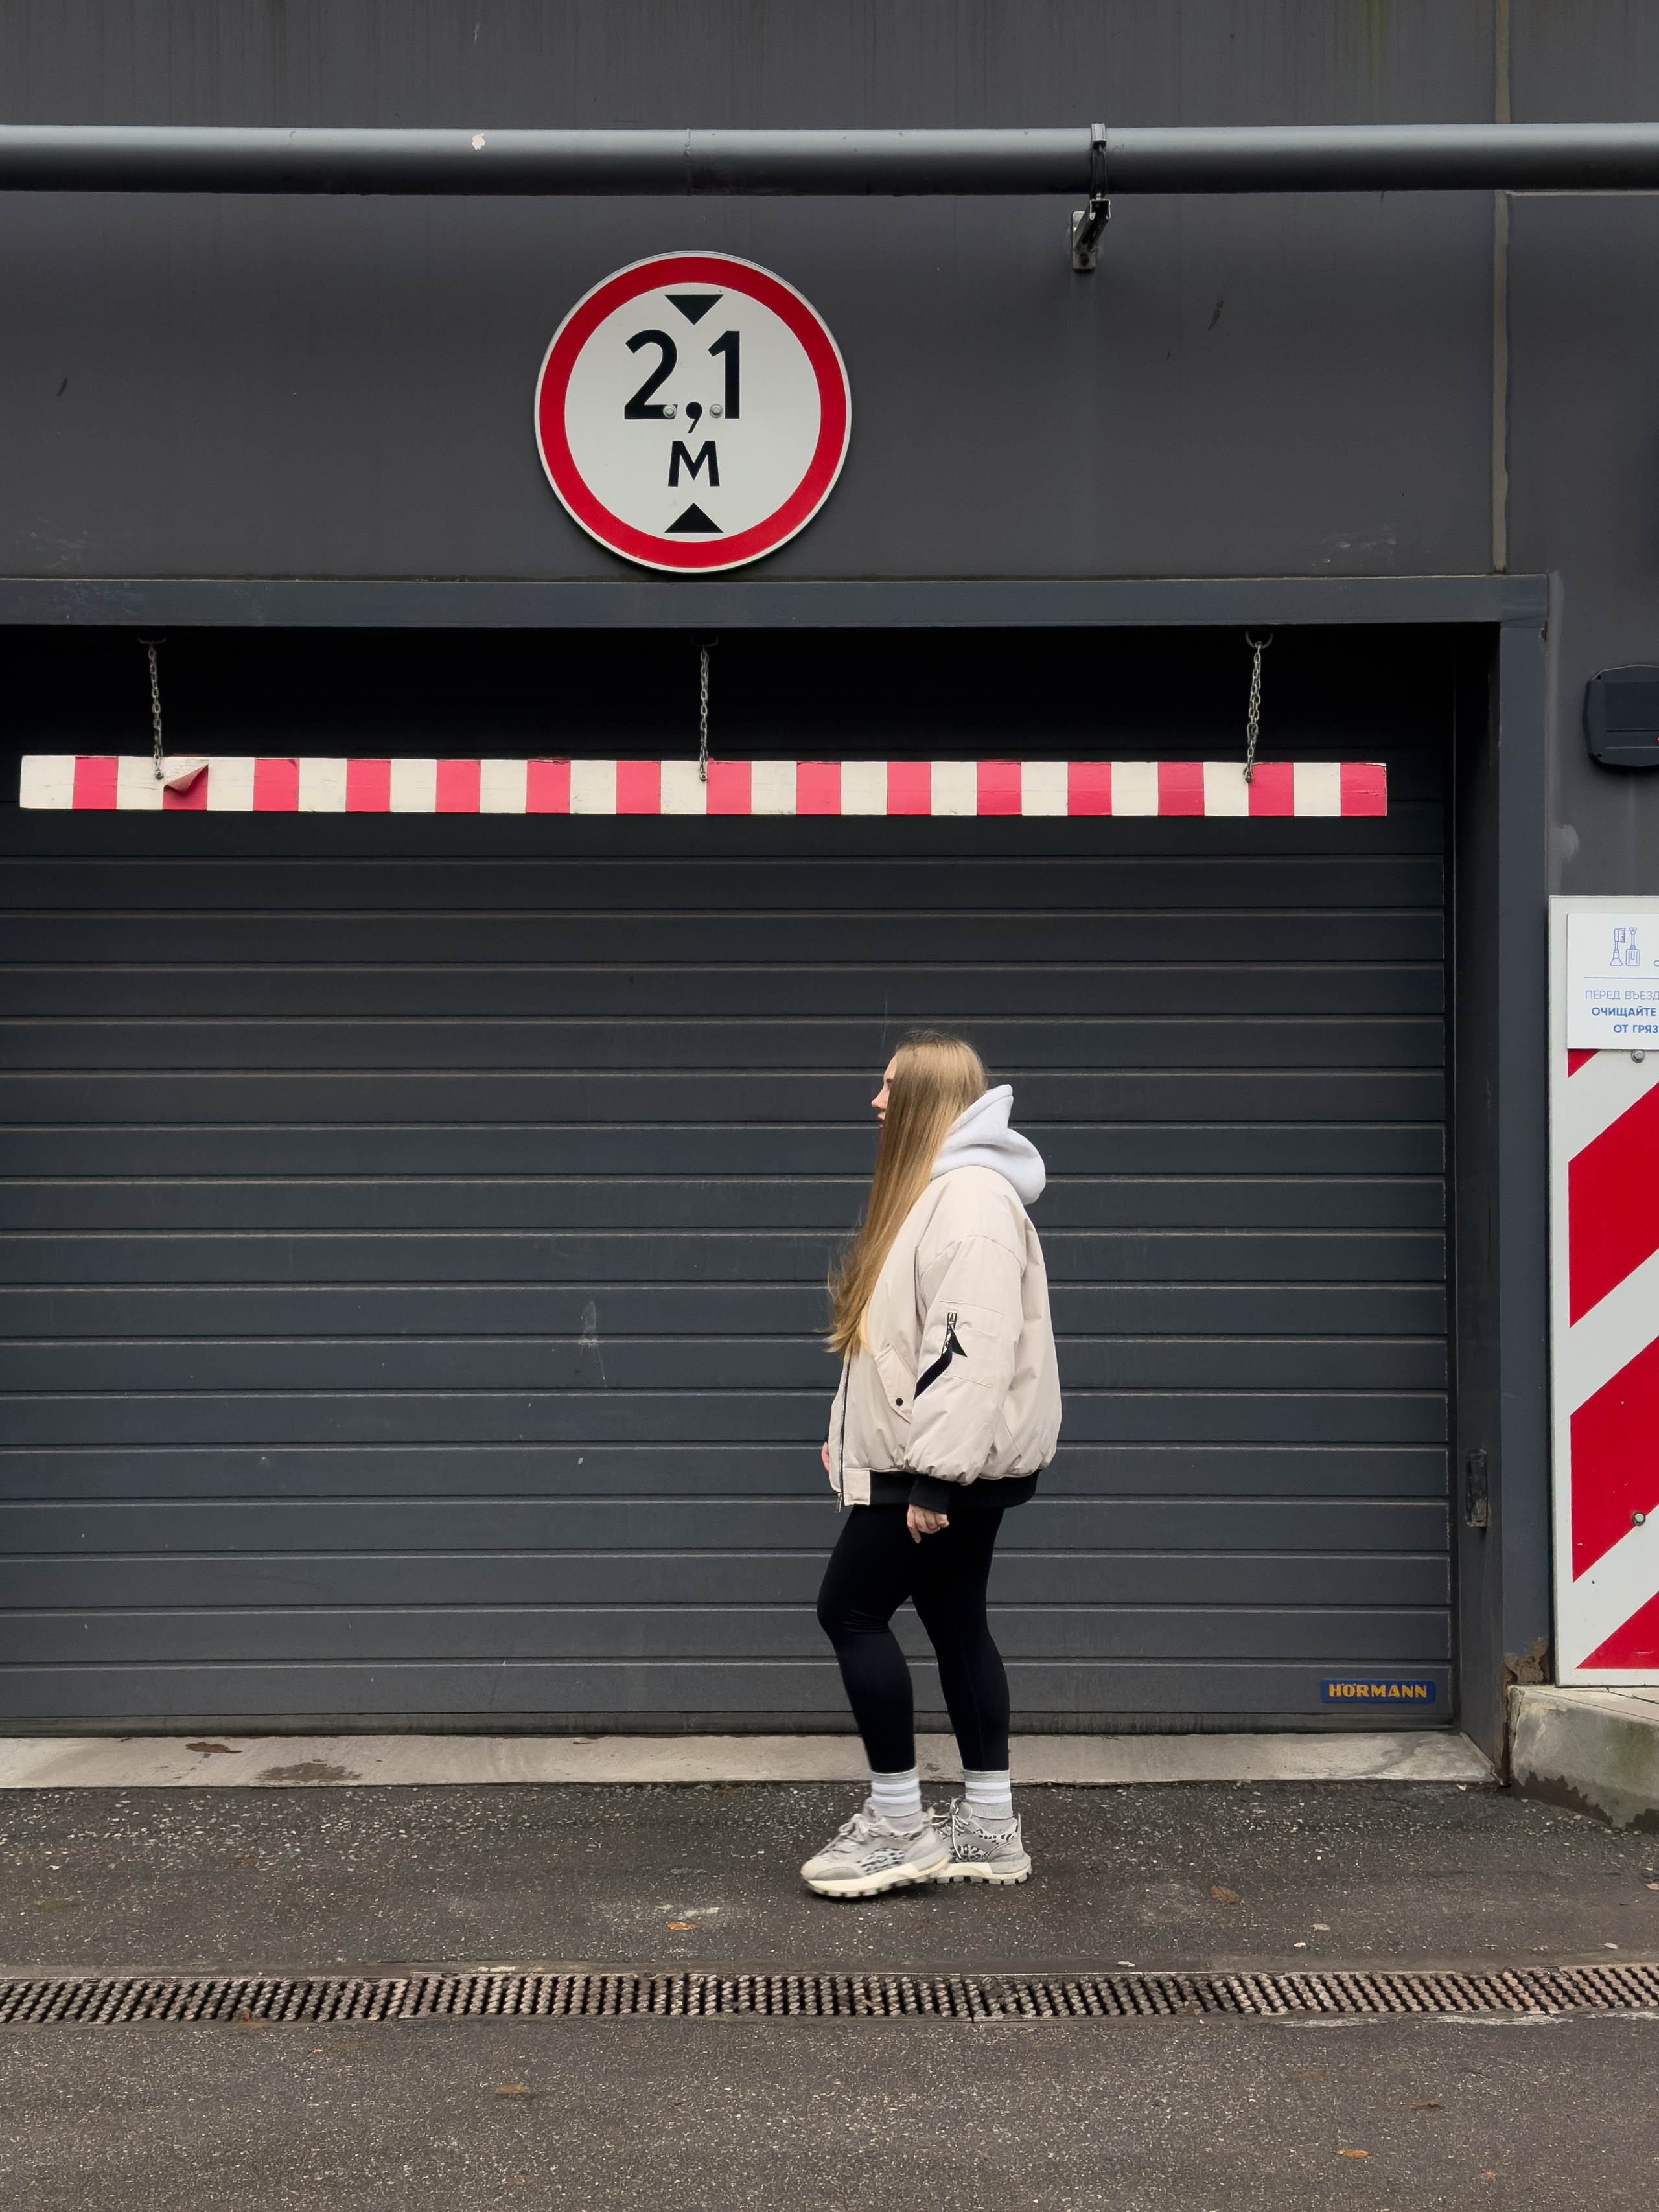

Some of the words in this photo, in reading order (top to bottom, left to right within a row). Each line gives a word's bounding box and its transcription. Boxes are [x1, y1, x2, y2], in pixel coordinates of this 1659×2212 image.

[623, 329, 740, 434] 2,1
[667, 440, 720, 487] М
[1585, 990, 1621, 1001] ПЕРЕД
[1591, 1005, 1656, 1017] ОЧИЩАЙТЕ
[1613, 1024, 1629, 1033] ОТ
